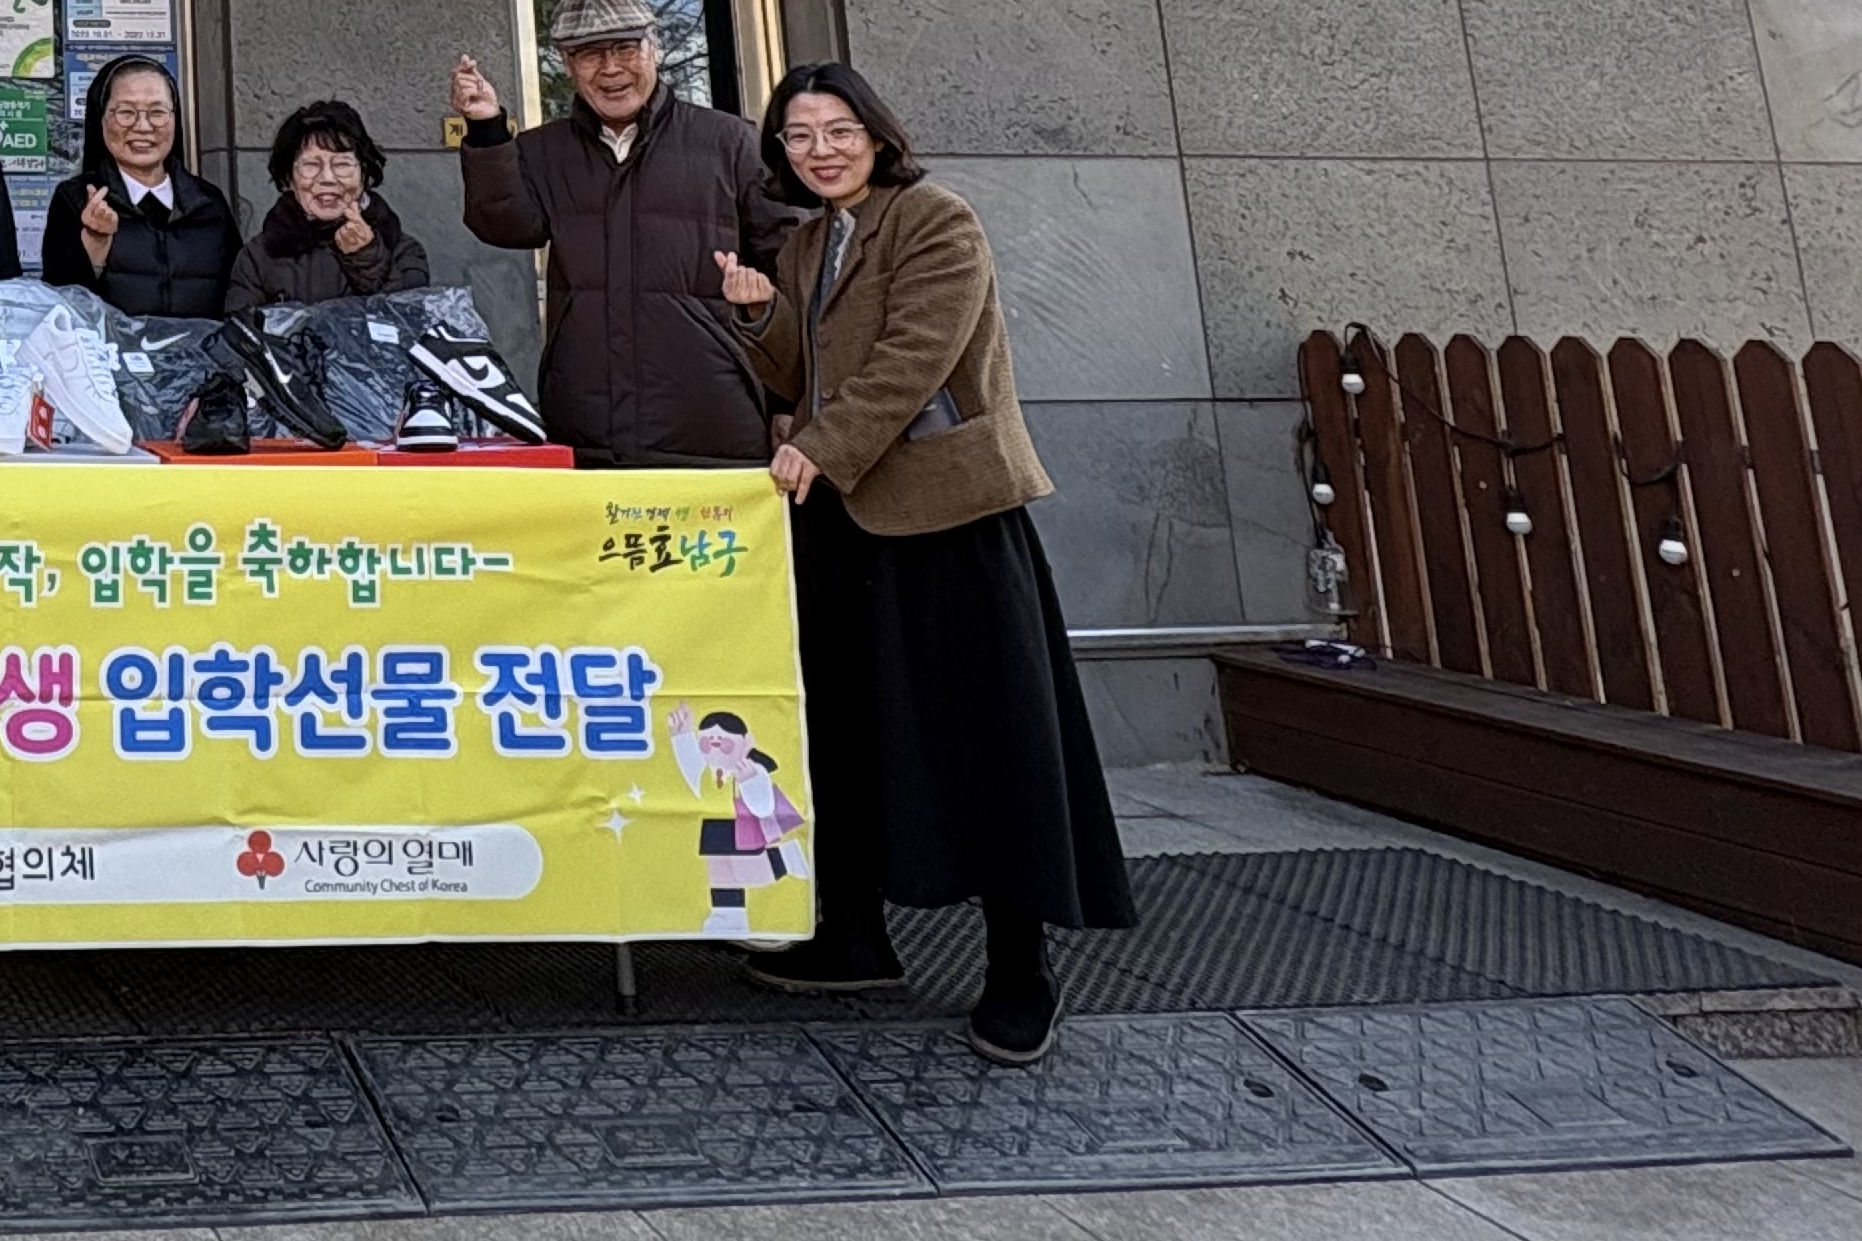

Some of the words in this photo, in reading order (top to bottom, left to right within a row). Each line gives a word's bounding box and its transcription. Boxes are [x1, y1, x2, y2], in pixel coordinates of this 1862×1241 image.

[2, 133, 38, 149] AED
[81, 526, 220, 605] 입학을
[104, 647, 460, 758] 입학선물
[477, 649, 660, 756] 전달
[294, 839, 394, 877] 사랑의
[402, 839, 474, 875] 열매
[304, 879, 378, 895] Community
[380, 879, 416, 893] Chest
[418, 878, 430, 893] of
[432, 879, 468, 893] Korea
